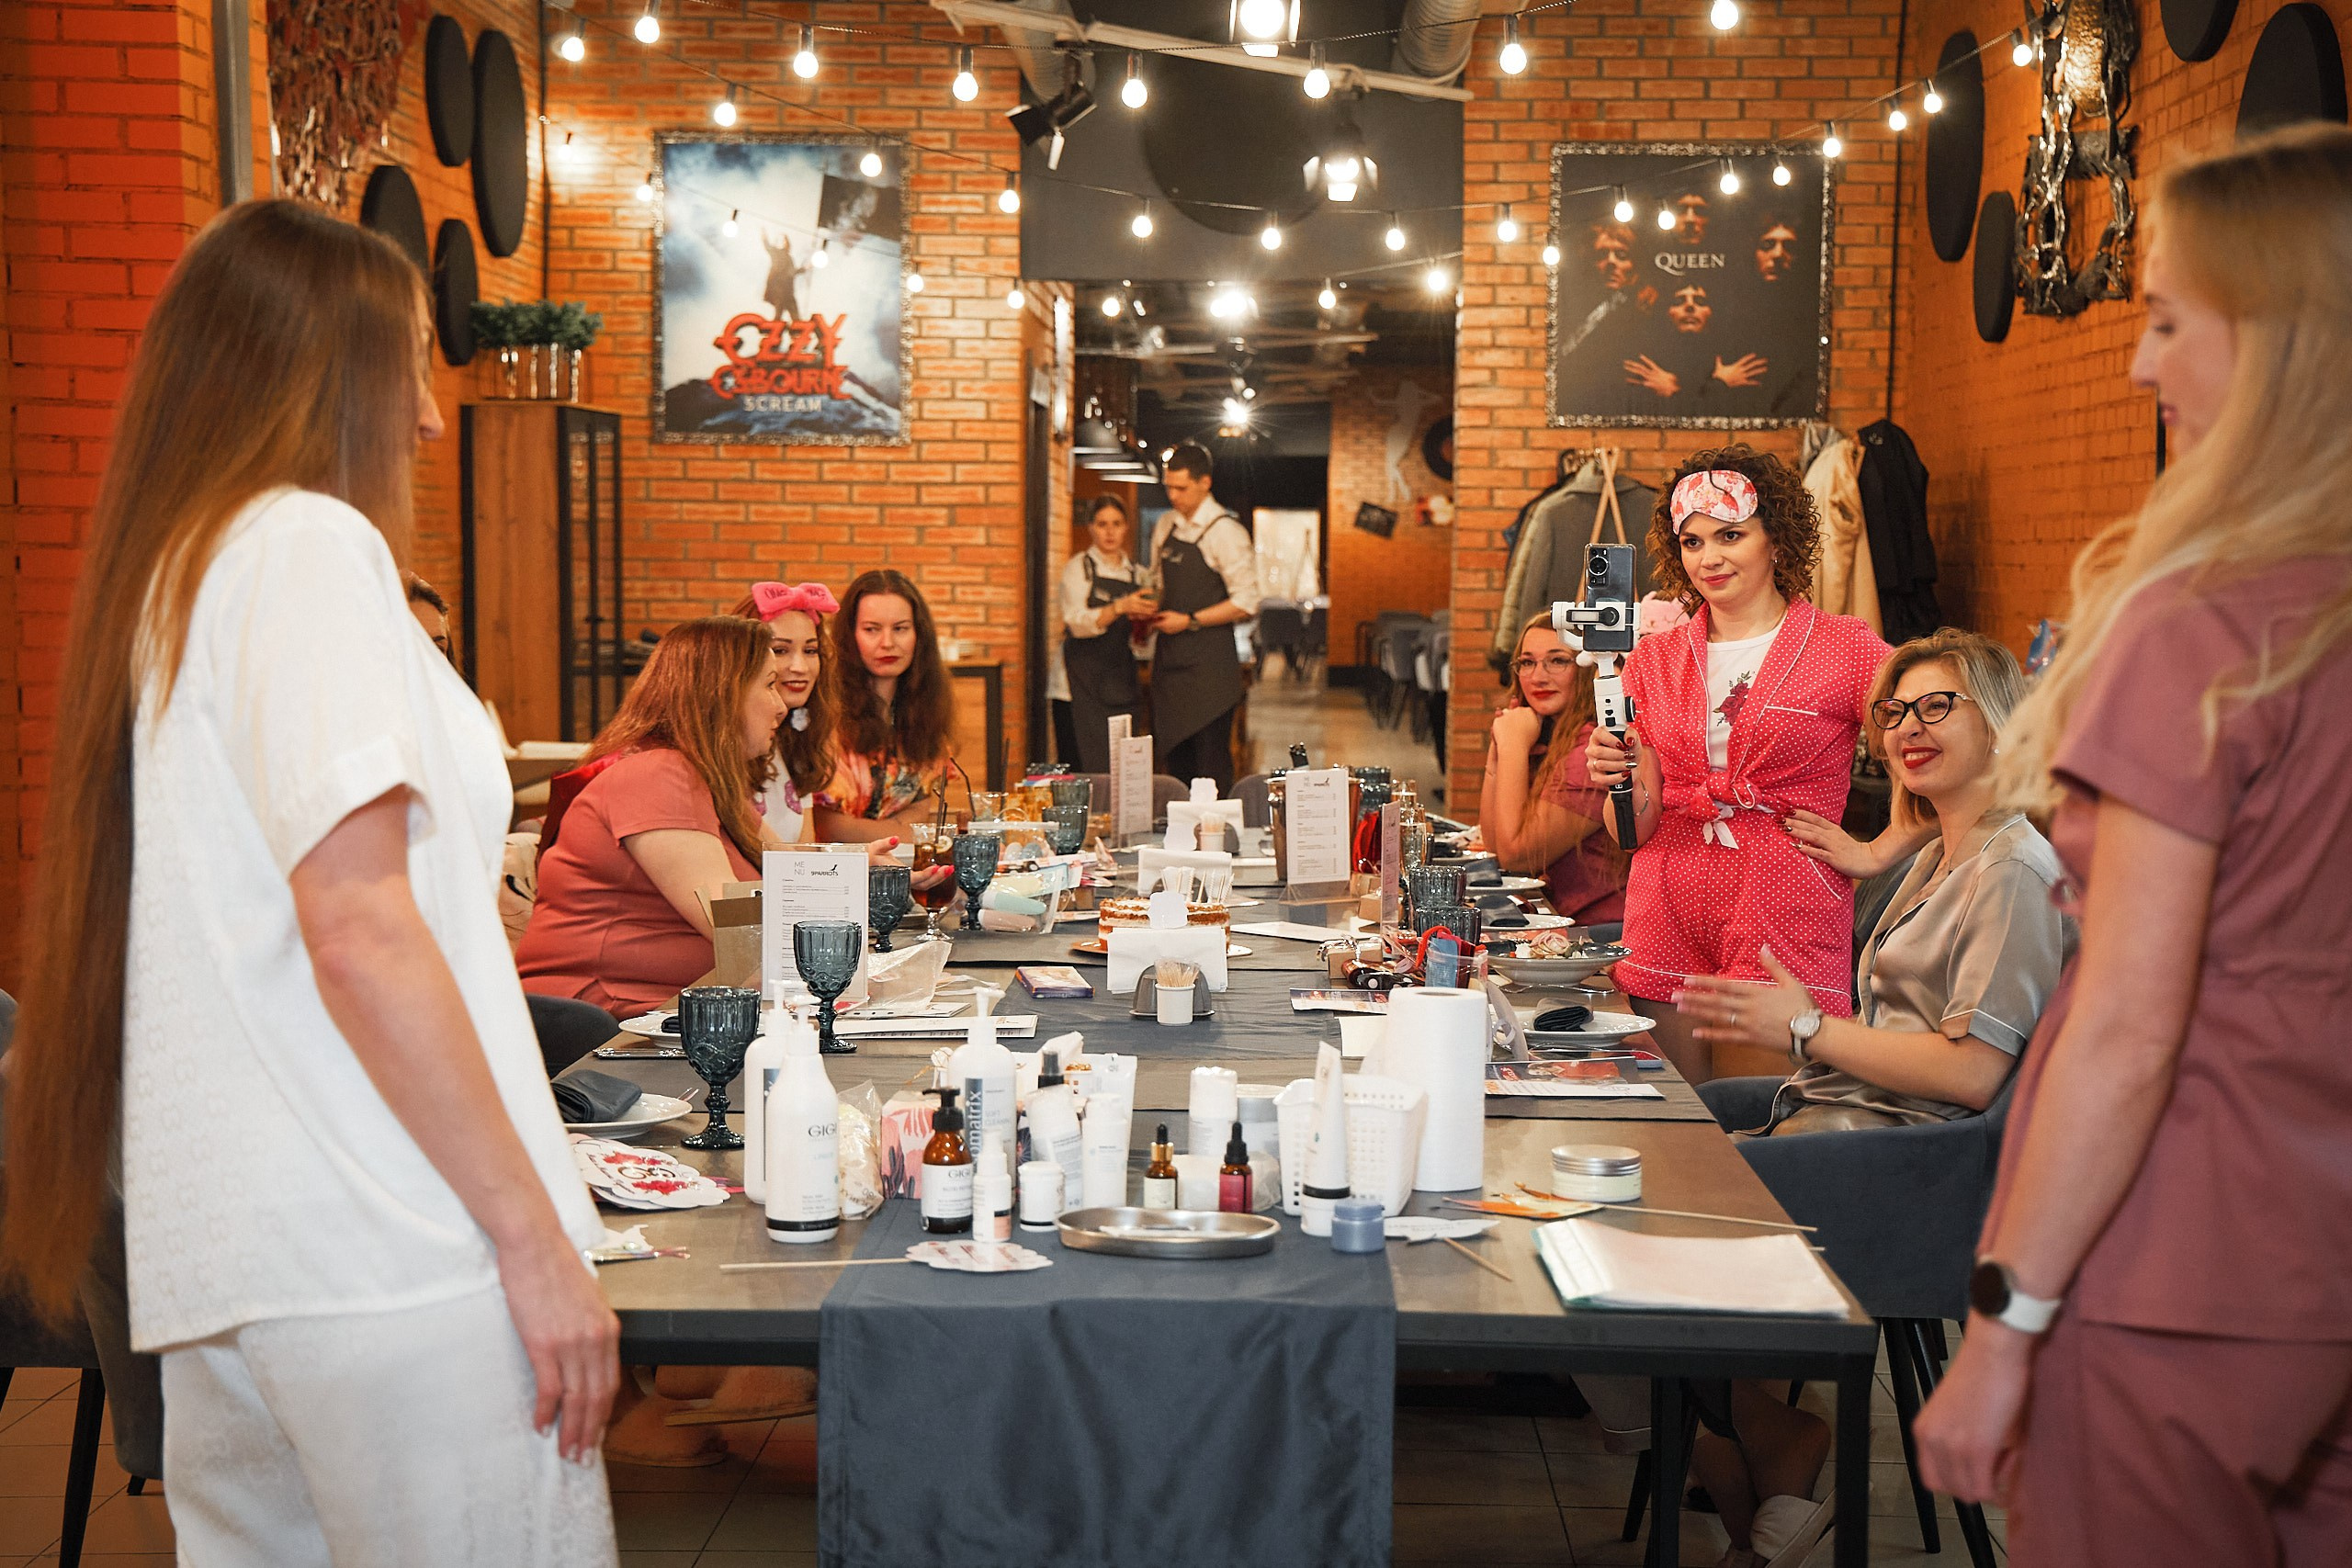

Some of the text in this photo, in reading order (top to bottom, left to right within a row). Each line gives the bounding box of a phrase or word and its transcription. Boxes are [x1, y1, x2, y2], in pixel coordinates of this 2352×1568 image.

[1655, 251, 1725, 276] QUEEN
[713, 312, 847, 366] OZZY
[742, 395, 822, 412] SCREAM
[808, 1122, 838, 1138] GIGI
[966, 1090, 982, 1163] omatrix
